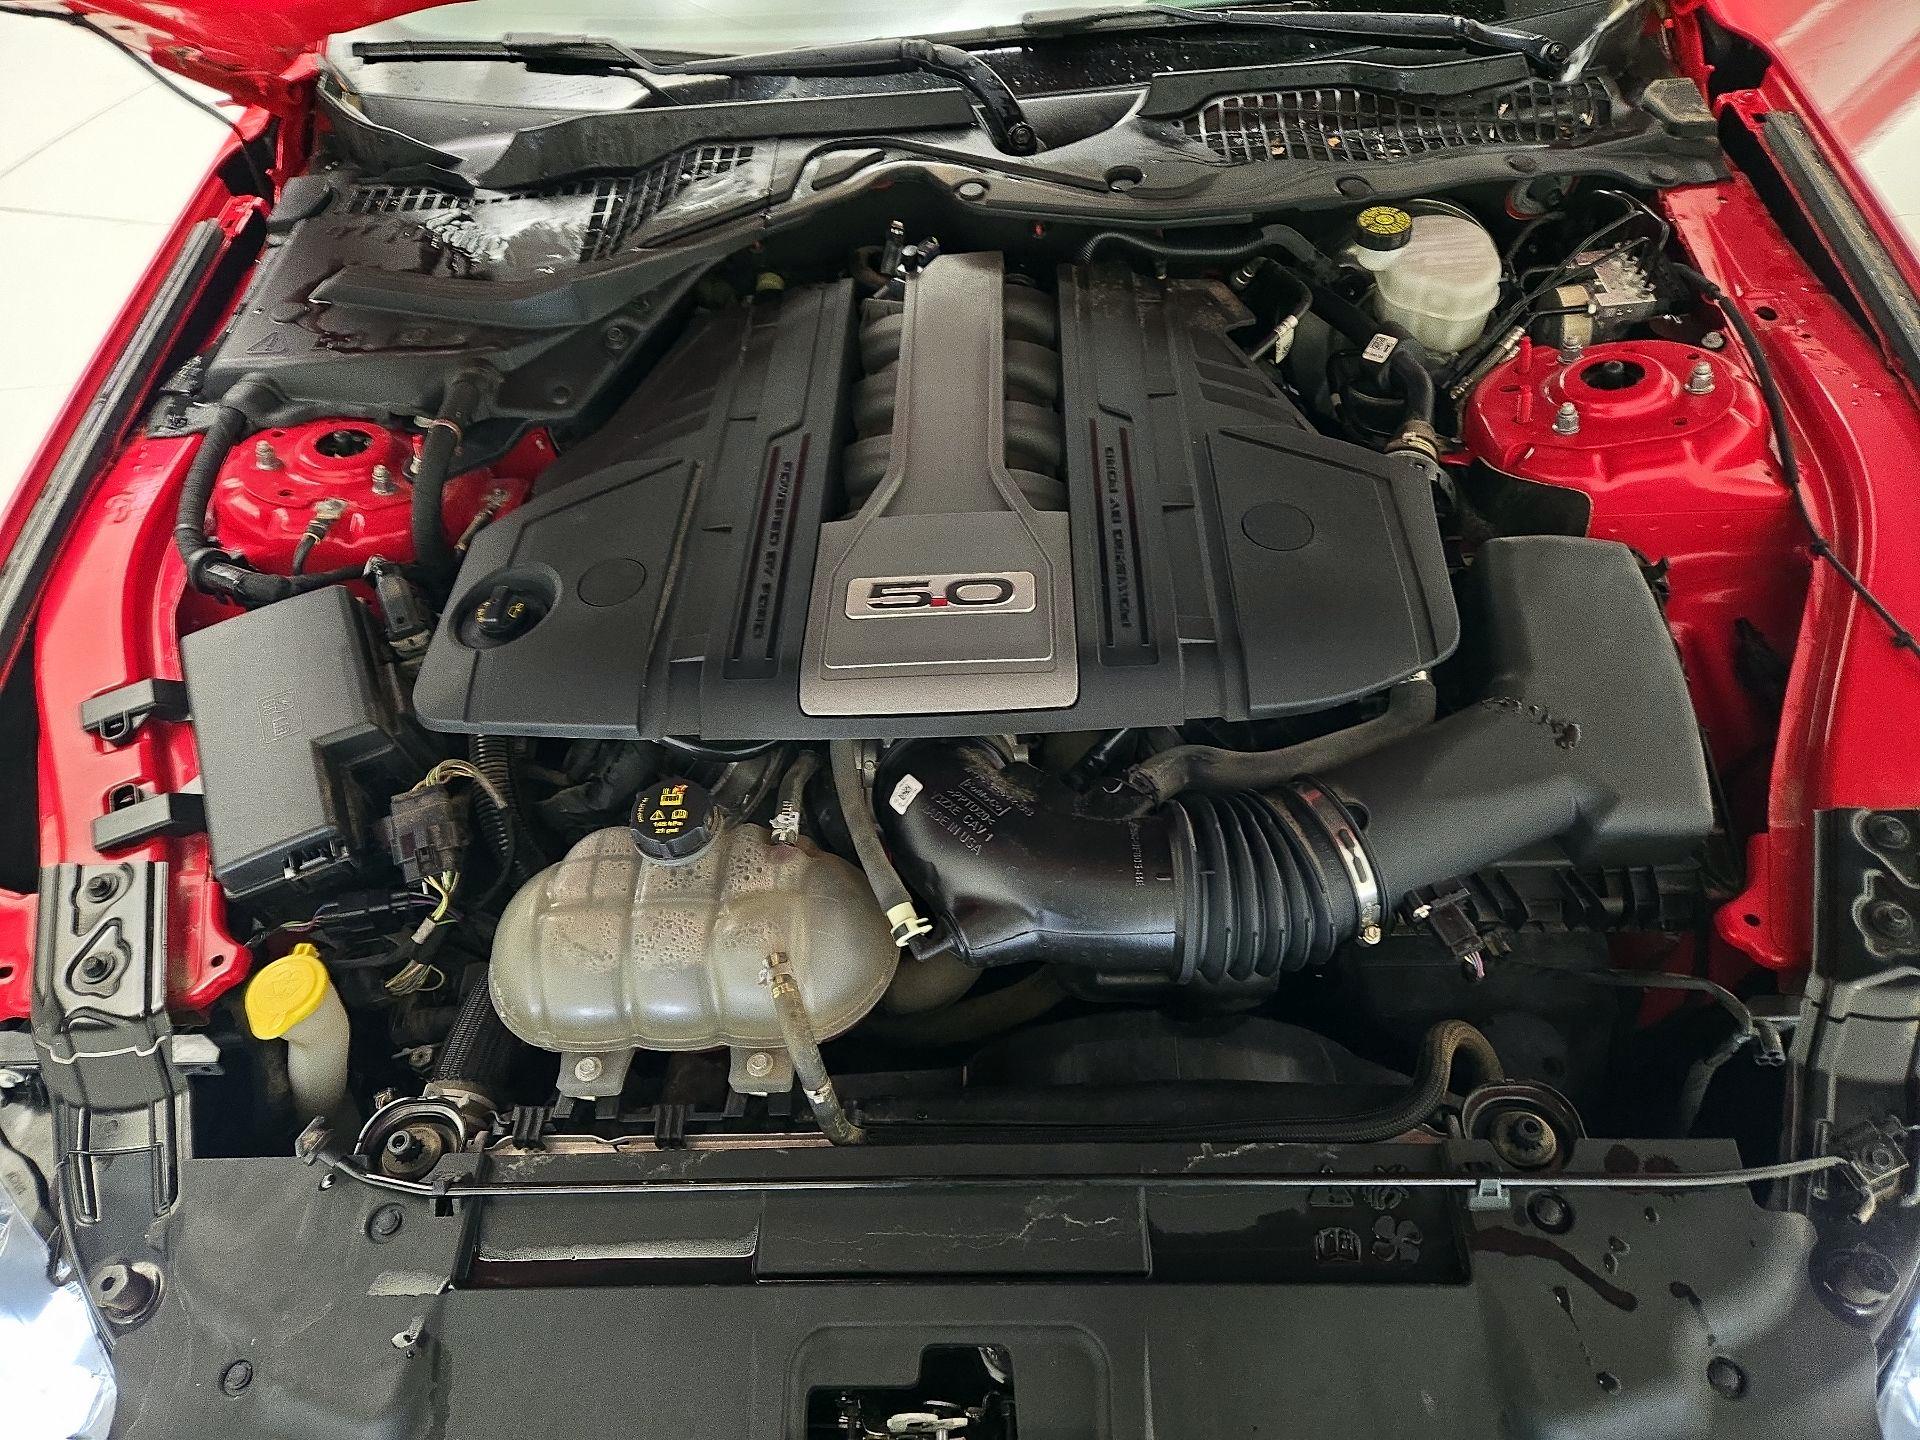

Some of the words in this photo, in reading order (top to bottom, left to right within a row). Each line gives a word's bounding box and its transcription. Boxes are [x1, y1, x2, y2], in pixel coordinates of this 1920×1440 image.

[867, 577, 1014, 609] 5.0
[947, 822, 961, 836] IN
[960, 832, 982, 855] USA
